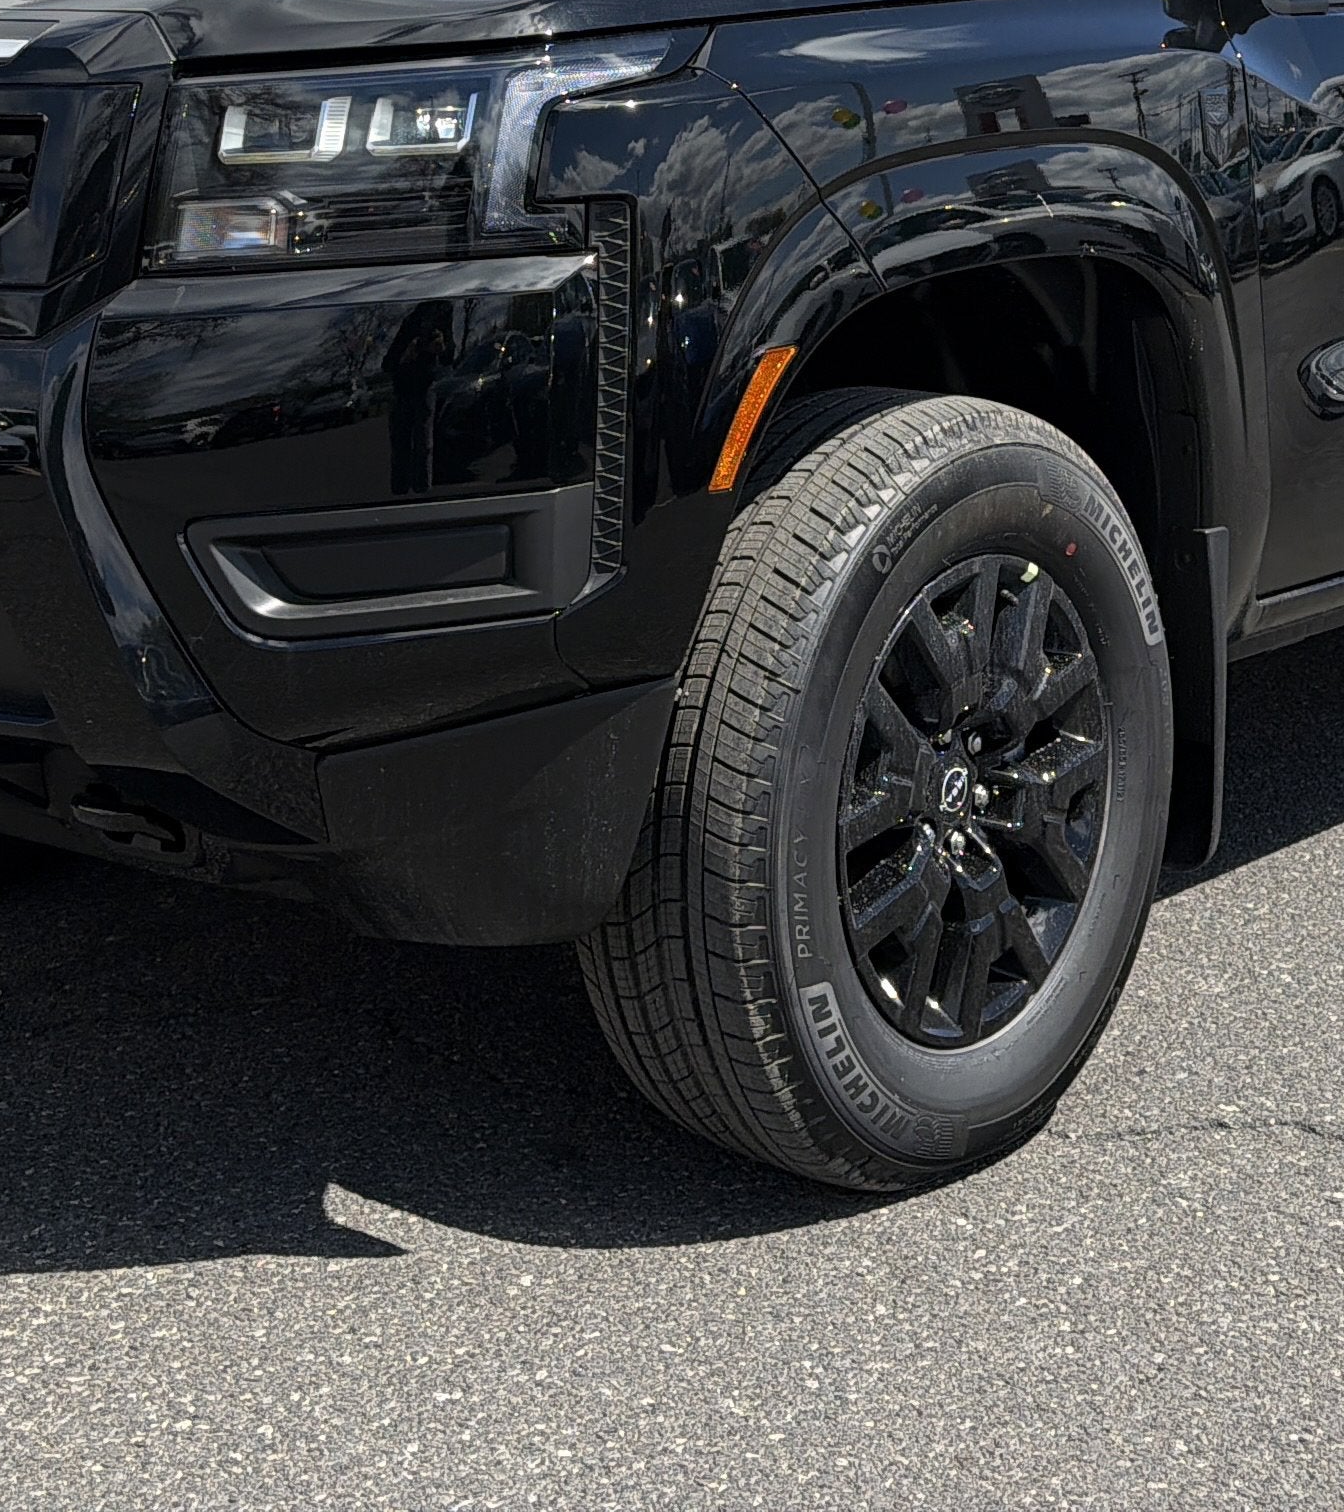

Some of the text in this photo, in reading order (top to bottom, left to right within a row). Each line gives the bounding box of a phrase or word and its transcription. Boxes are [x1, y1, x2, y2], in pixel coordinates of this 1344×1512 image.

[1083, 492, 1159, 636] MICHELIN
[792, 830, 814, 960] PRIMACY
[807, 992, 910, 1142] MICHELIN
